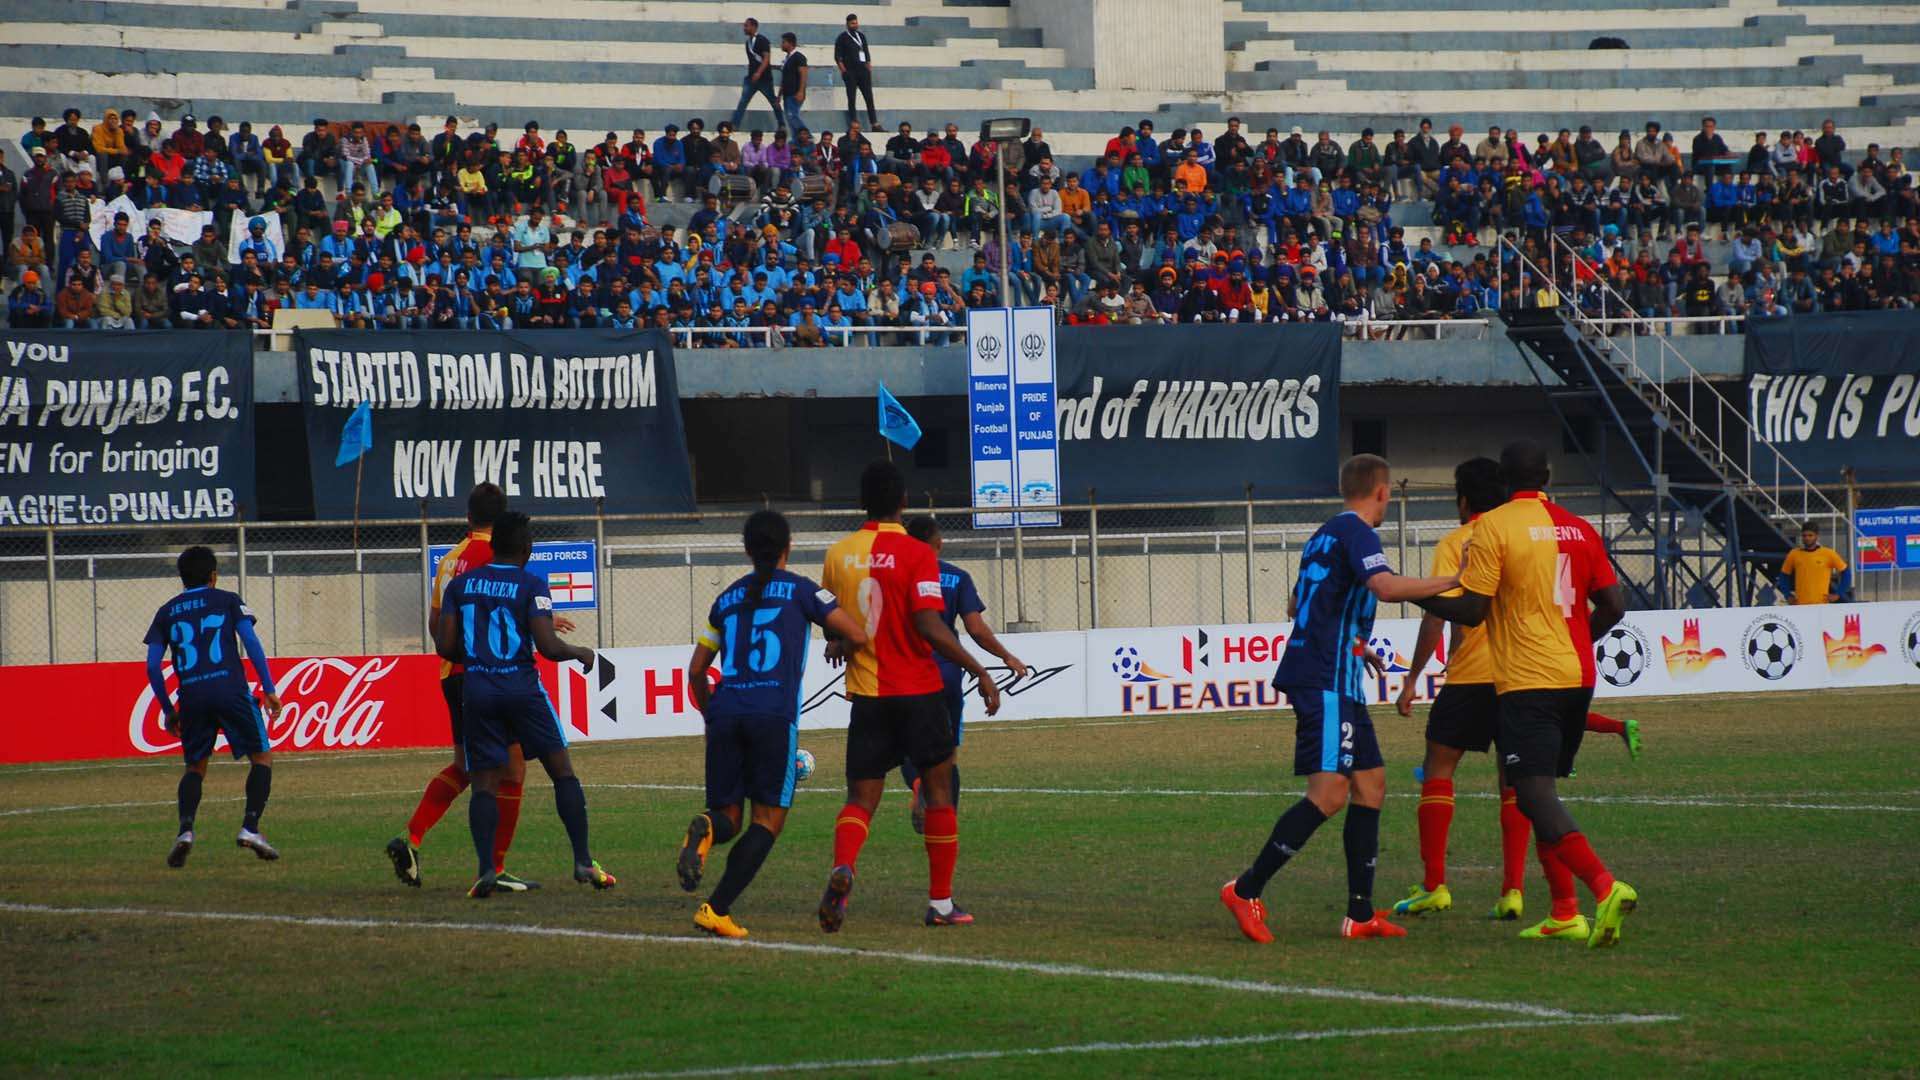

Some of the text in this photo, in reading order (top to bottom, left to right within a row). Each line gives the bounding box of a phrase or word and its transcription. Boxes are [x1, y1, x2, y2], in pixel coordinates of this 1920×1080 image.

[7, 341, 69, 366] you
[310, 348, 656, 410] STARTED FROM DA BOTTOM
[975, 381, 1008, 391] Minerva
[37, 375, 173, 434] PUNJAB
[177, 366, 239, 422] F.C.
[976, 402, 1005, 414] Punjab
[1022, 392, 1048, 403] PRIDE
[1100, 379, 1149, 440] of
[1145, 374, 1321, 440] WARRIORS
[1749, 373, 1827, 442] THIS
[1827, 373, 1873, 440] IS
[974, 424, 1008, 433] Football
[1029, 411, 1041, 421] OF
[1018, 430, 1054, 440] PUNJAB
[49, 442, 93, 474] for
[102, 440, 219, 478] bringing
[982, 445, 1002, 455] Club
[393, 438, 606, 498] NOW WE HERE
[80, 495, 107, 523] to
[108, 488, 235, 522] PUNJAB
[528, 550, 588, 561] RMED FORCES
[844, 553, 896, 569] PLAZA
[464, 578, 519, 599] KAREEM
[1553, 553, 1577, 618] 4
[169, 598, 207, 616] JEWEL
[857, 577, 884, 640] 9
[170, 613, 225, 671] 37
[459, 603, 521, 660] 10
[721, 607, 782, 677] 15
[1224, 635, 1285, 663] Her
[1341, 722, 1353, 749] 2
